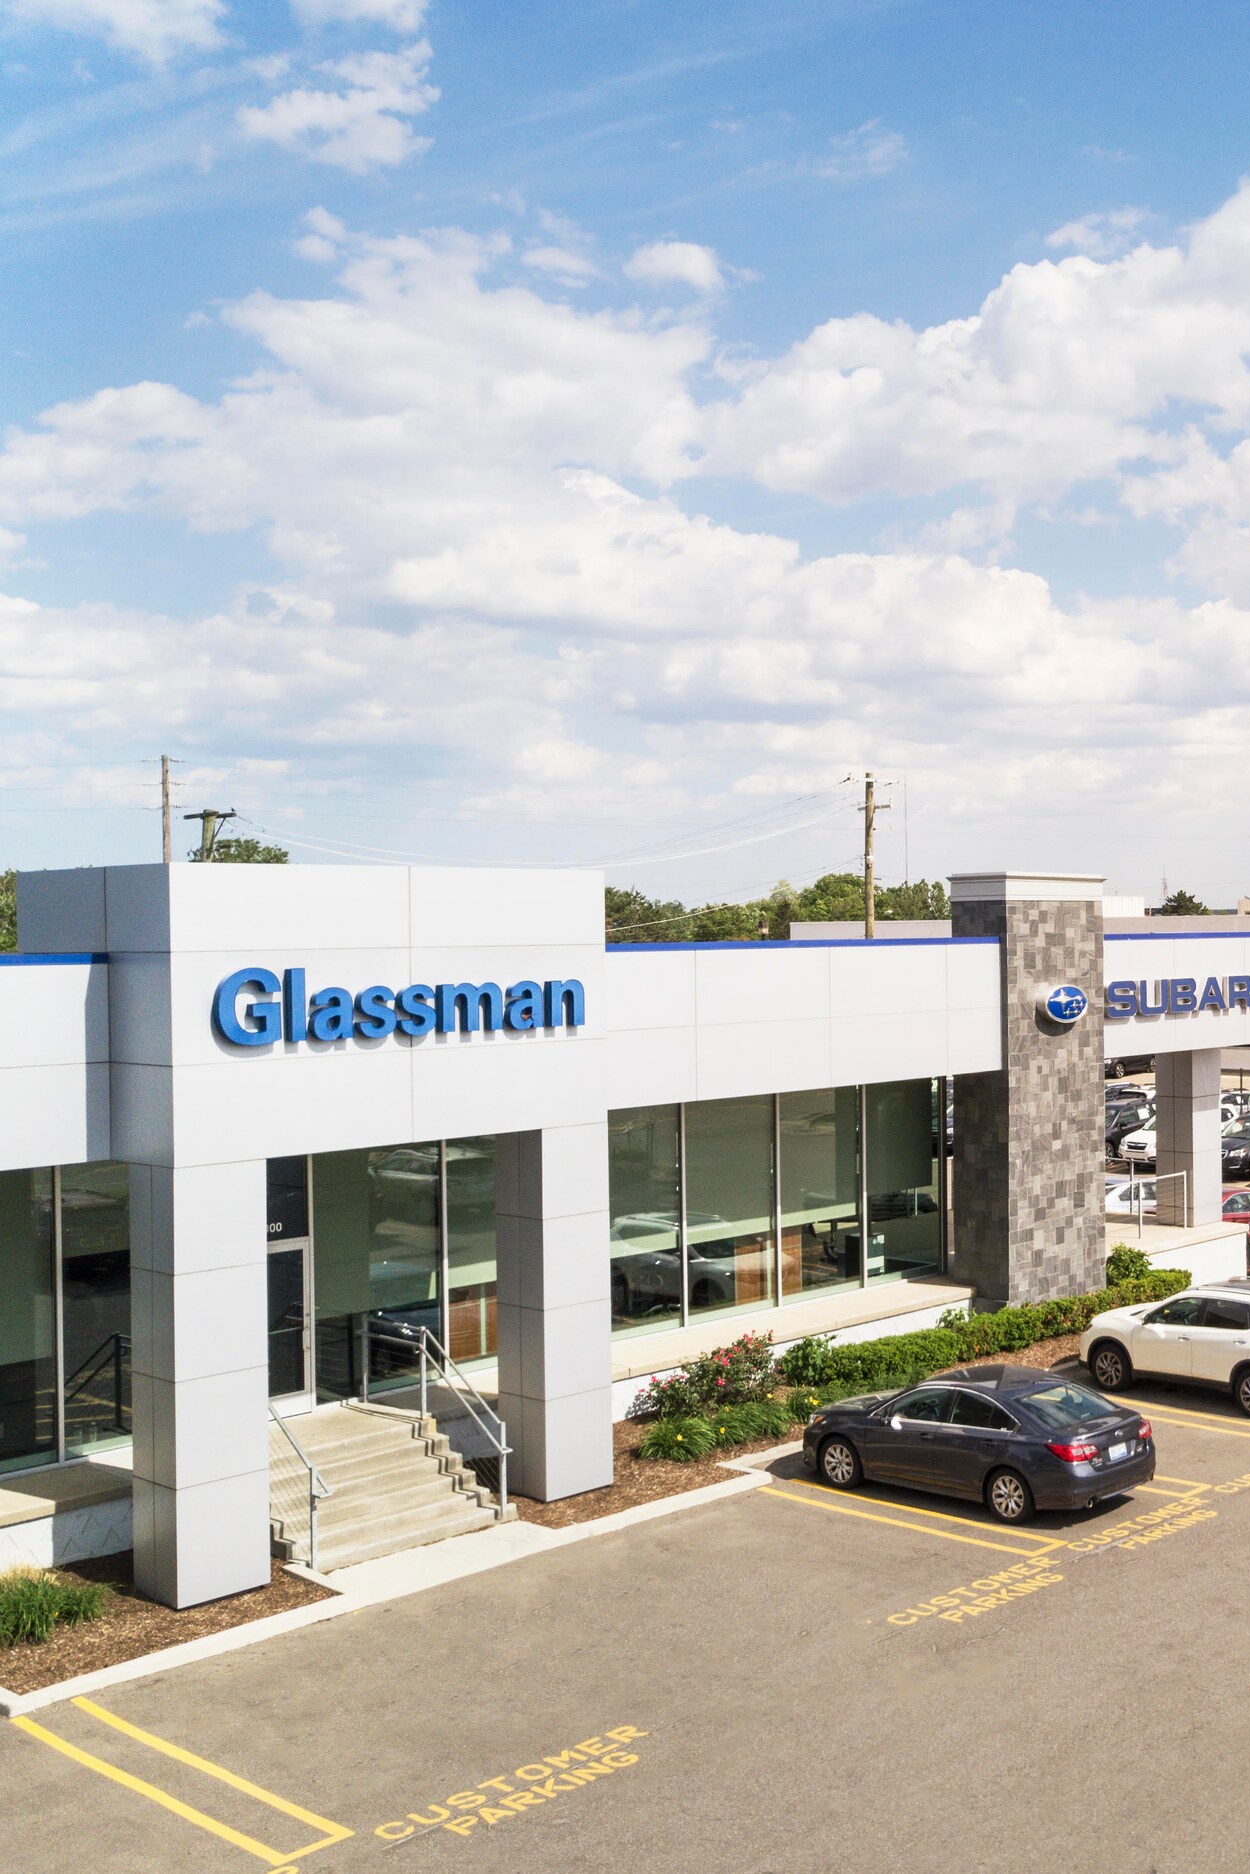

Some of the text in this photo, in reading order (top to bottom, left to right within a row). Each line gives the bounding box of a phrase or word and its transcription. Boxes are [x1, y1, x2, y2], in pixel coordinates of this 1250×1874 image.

[212, 967, 586, 1047] Glassman
[1067, 1497, 1210, 1551] CUSTOMER
[1117, 1509, 1218, 1549] PARKING
[887, 1556, 1061, 1625] CUSTOMER
[937, 1572, 1064, 1623] PARKING
[374, 1725, 649, 1841] CUSTOMER
[443, 1751, 639, 1836] PARKING
